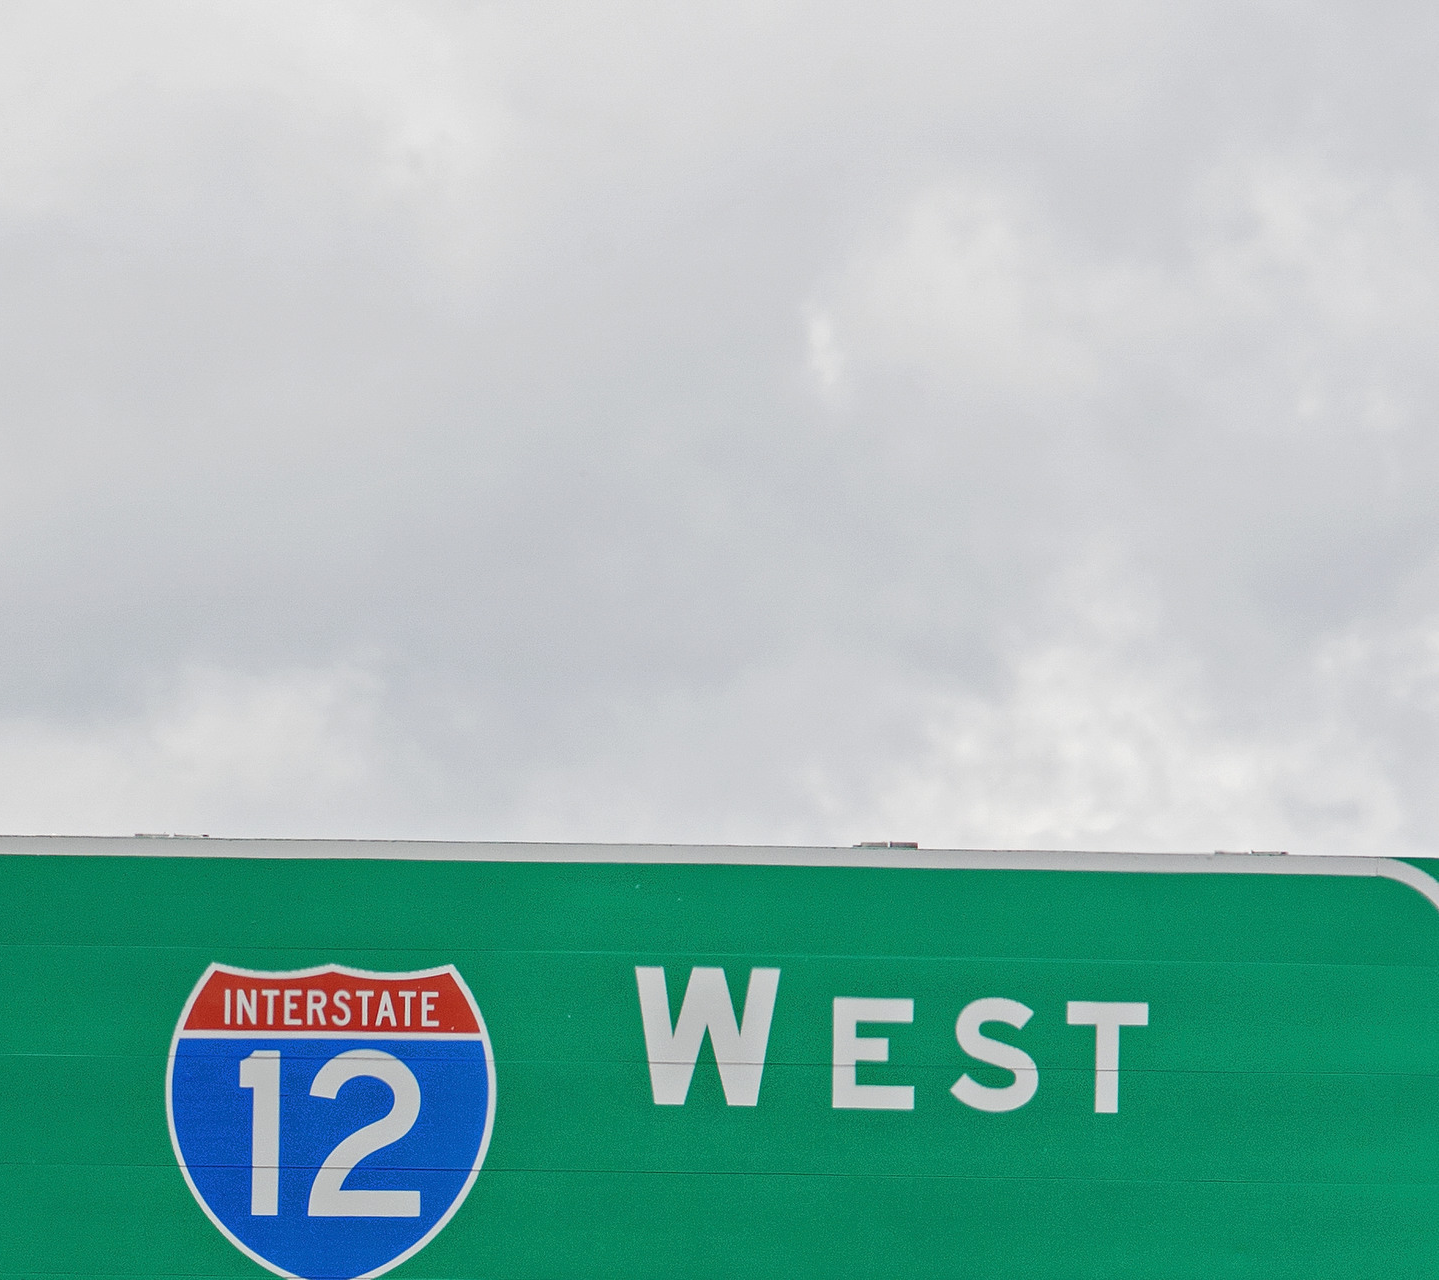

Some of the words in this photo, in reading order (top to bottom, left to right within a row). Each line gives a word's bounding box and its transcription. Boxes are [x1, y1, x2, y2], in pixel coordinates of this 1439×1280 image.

[224, 988, 440, 1028] INTERSTATE
[636, 965, 1149, 1115] WEST
[239, 1048, 422, 1218] 12
